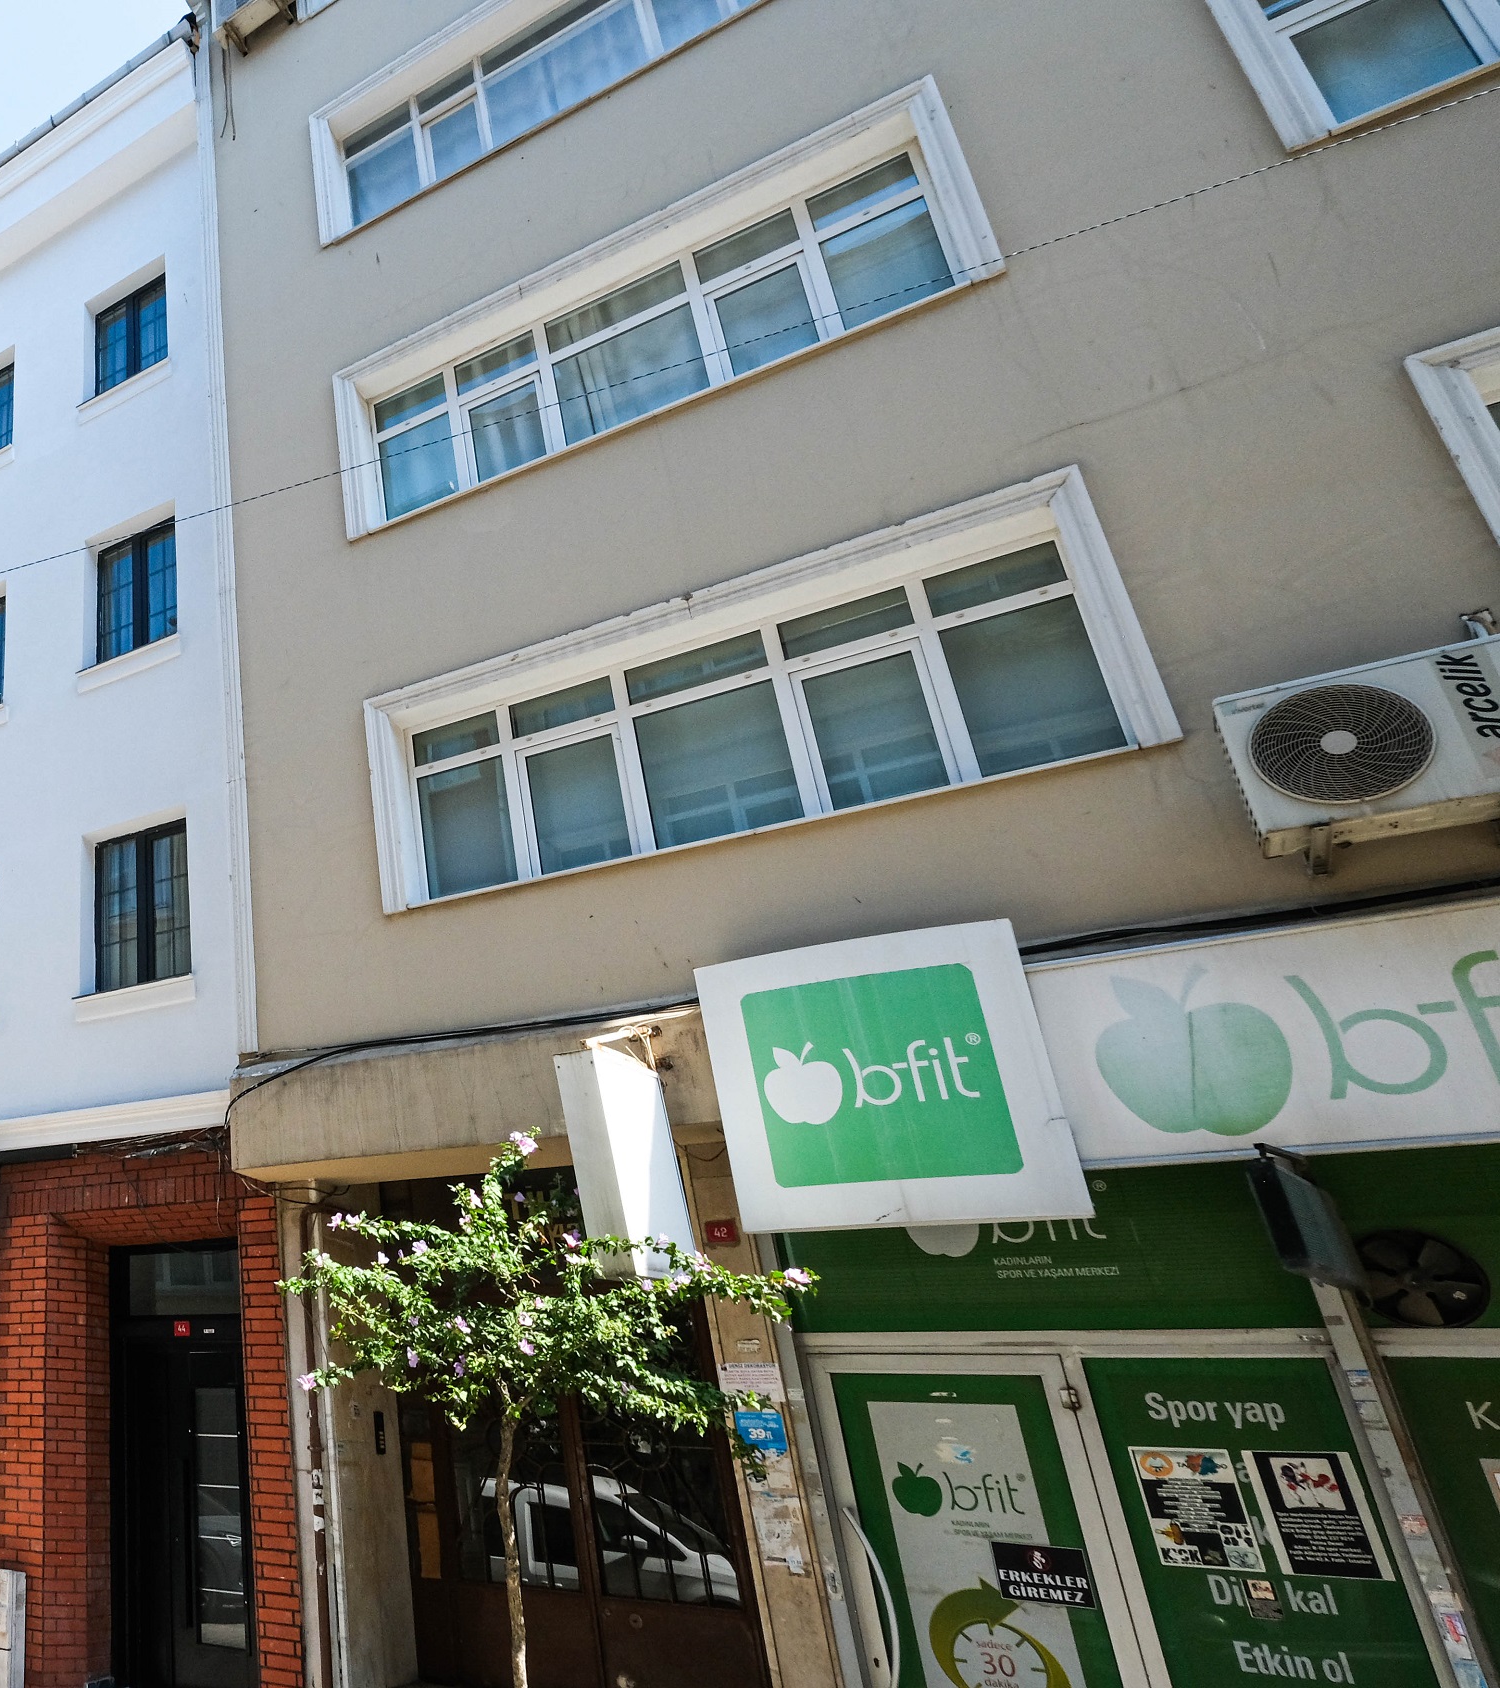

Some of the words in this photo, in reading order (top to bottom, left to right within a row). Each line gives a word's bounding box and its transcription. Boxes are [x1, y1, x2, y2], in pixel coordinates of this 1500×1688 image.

[713, 1227, 728, 1238] 42
[992, 1255, 1052, 1265] KADINLARIN
[997, 1269, 1023, 1278] SPOR
[1023, 1269, 1037, 1278] VE
[1038, 1268, 1075, 1279] YAŞAM
[1144, 1392, 1218, 1428] Spor
[1223, 1401, 1286, 1431] yap
[998, 1569, 1089, 1590] ERKEKLER
[1008, 1583, 1086, 1604] GİREMEZ
[1283, 1580, 1339, 1615] kal
[980, 1652, 1016, 1677] 30
[1232, 1640, 1317, 1680] Etkin
[1321, 1651, 1356, 1685] ol
